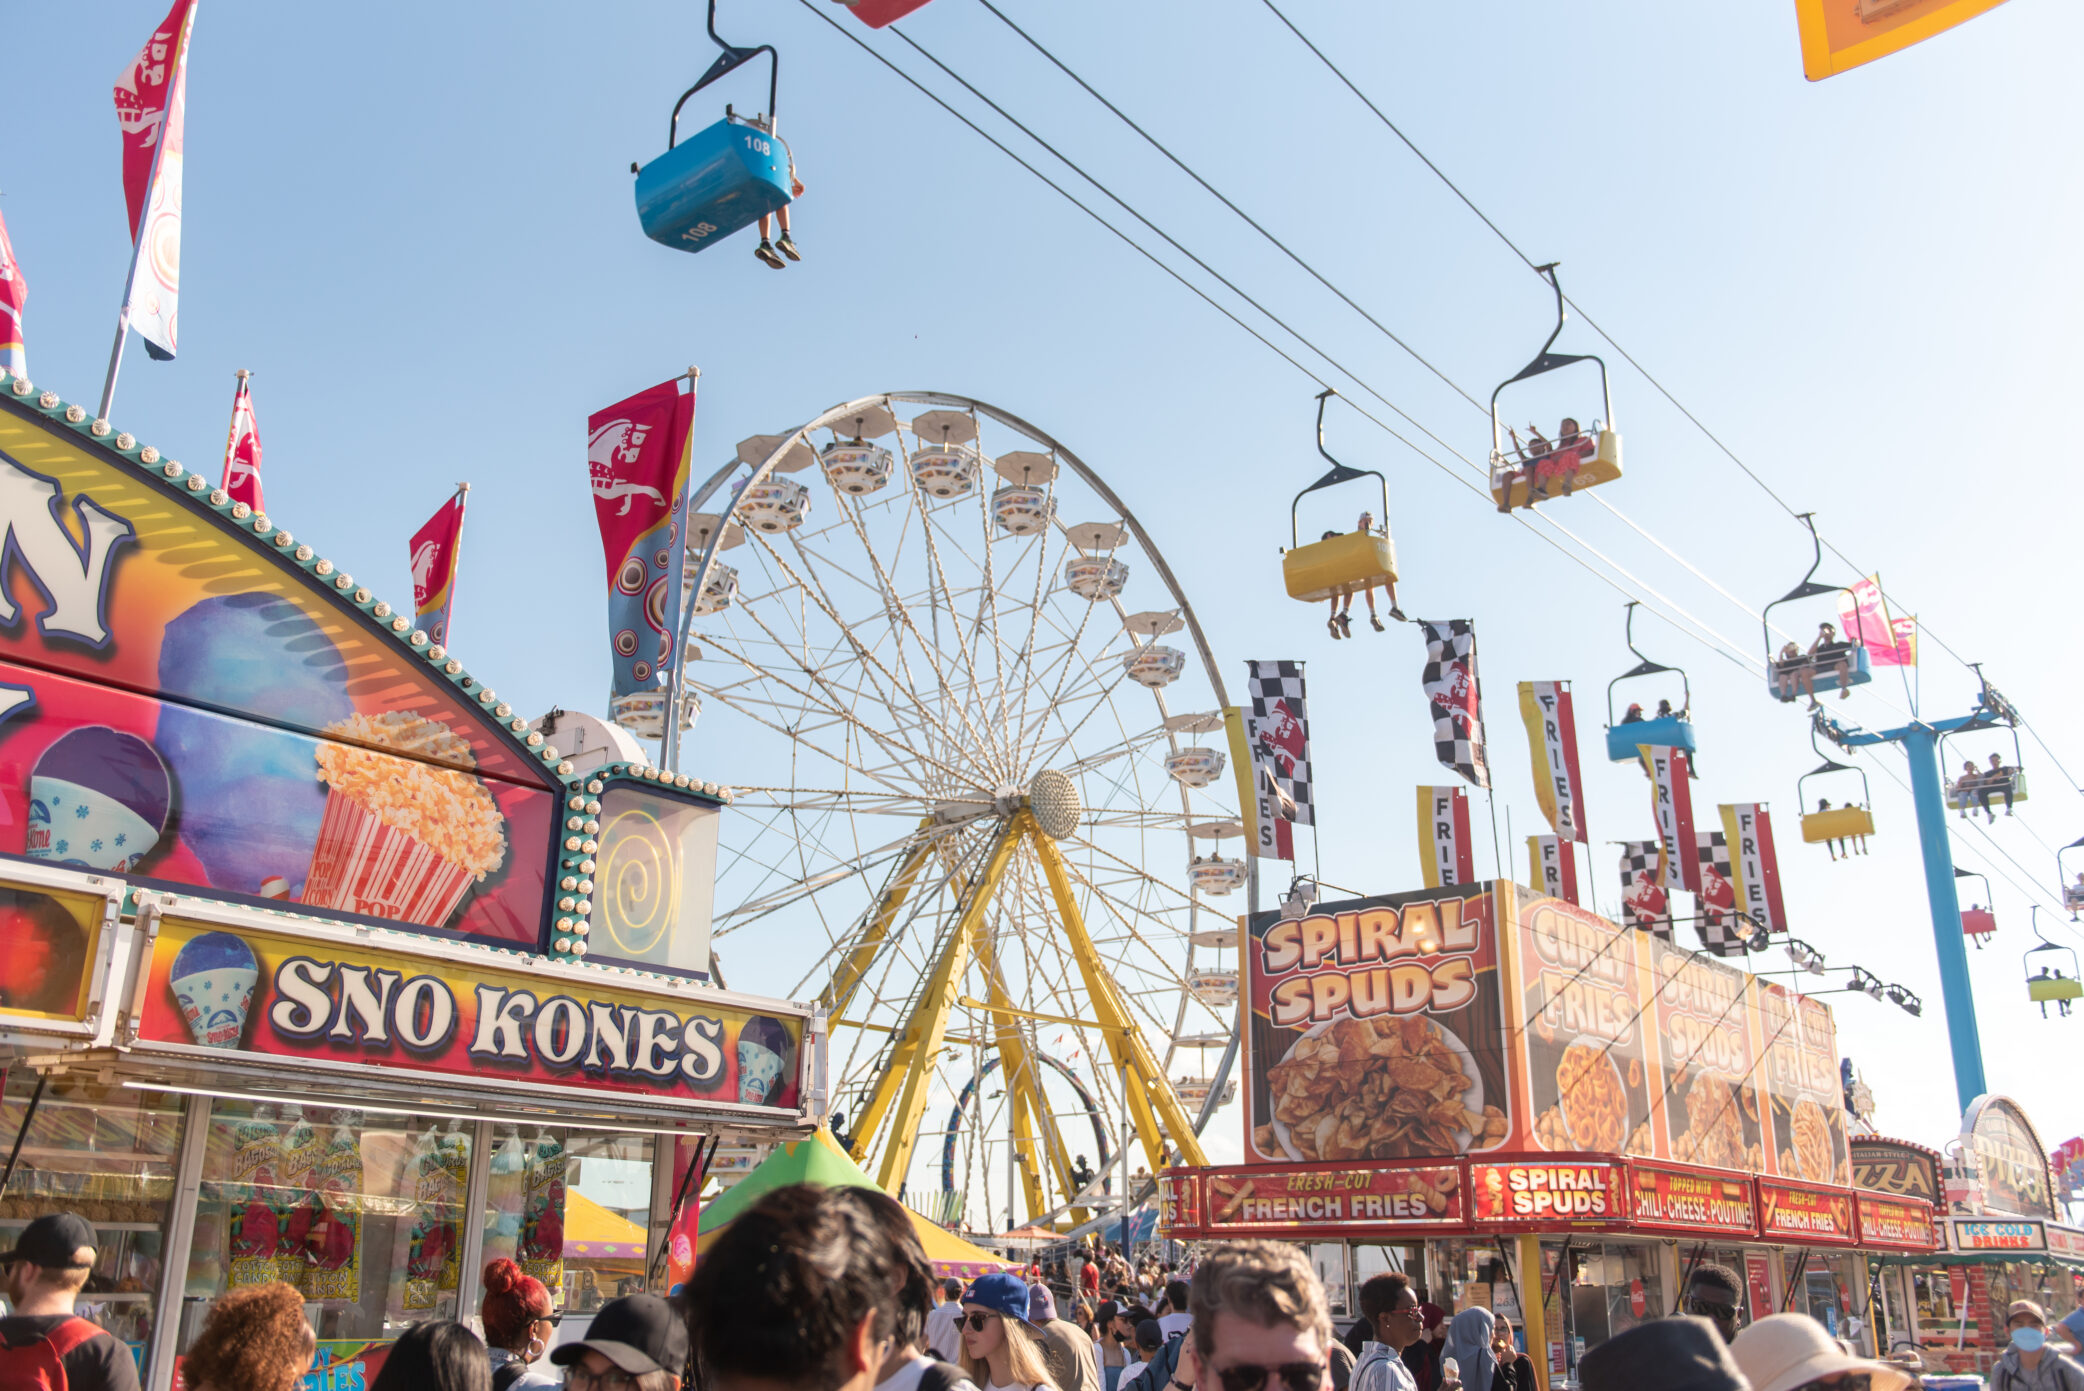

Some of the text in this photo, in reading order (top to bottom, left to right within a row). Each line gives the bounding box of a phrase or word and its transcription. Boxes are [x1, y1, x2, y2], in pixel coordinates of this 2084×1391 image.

[744, 136, 770, 157] 108
[682, 222, 718, 242] 108
[1539, 695, 1573, 827] FRIES
[1249, 718, 1273, 846] FRIES
[1655, 758, 1678, 880] FRIES
[1741, 814, 1766, 925] FRIES
[354, 900, 401, 919] POP
[1264, 899, 1478, 974] SPIRAL
[1533, 907, 1629, 987] CURLY
[1271, 957, 1477, 1026] SPUDS
[1661, 954, 1743, 1027] SPIRAL
[272, 956, 725, 1081] SNO KONES
[1542, 970, 1633, 1045] FRIES
[1670, 1013, 1745, 1075] SPUDS
[1853, 1151, 1905, 1159] ITALIAN STYLE
[1287, 1174, 1372, 1191] FRESH-CUT
[1508, 1168, 1606, 1191] SPIRAL
[1669, 1176, 1712, 1196] TOPPED WITH
[1242, 1192, 1427, 1220] FRENCH FRIES
[1513, 1190, 1606, 1215] SPUDS
[1774, 1208, 1834, 1233] FRENCH FRIES
[1965, 1223, 2033, 1236] ICE COLD
[1972, 1236, 2030, 1249] DRINKS
